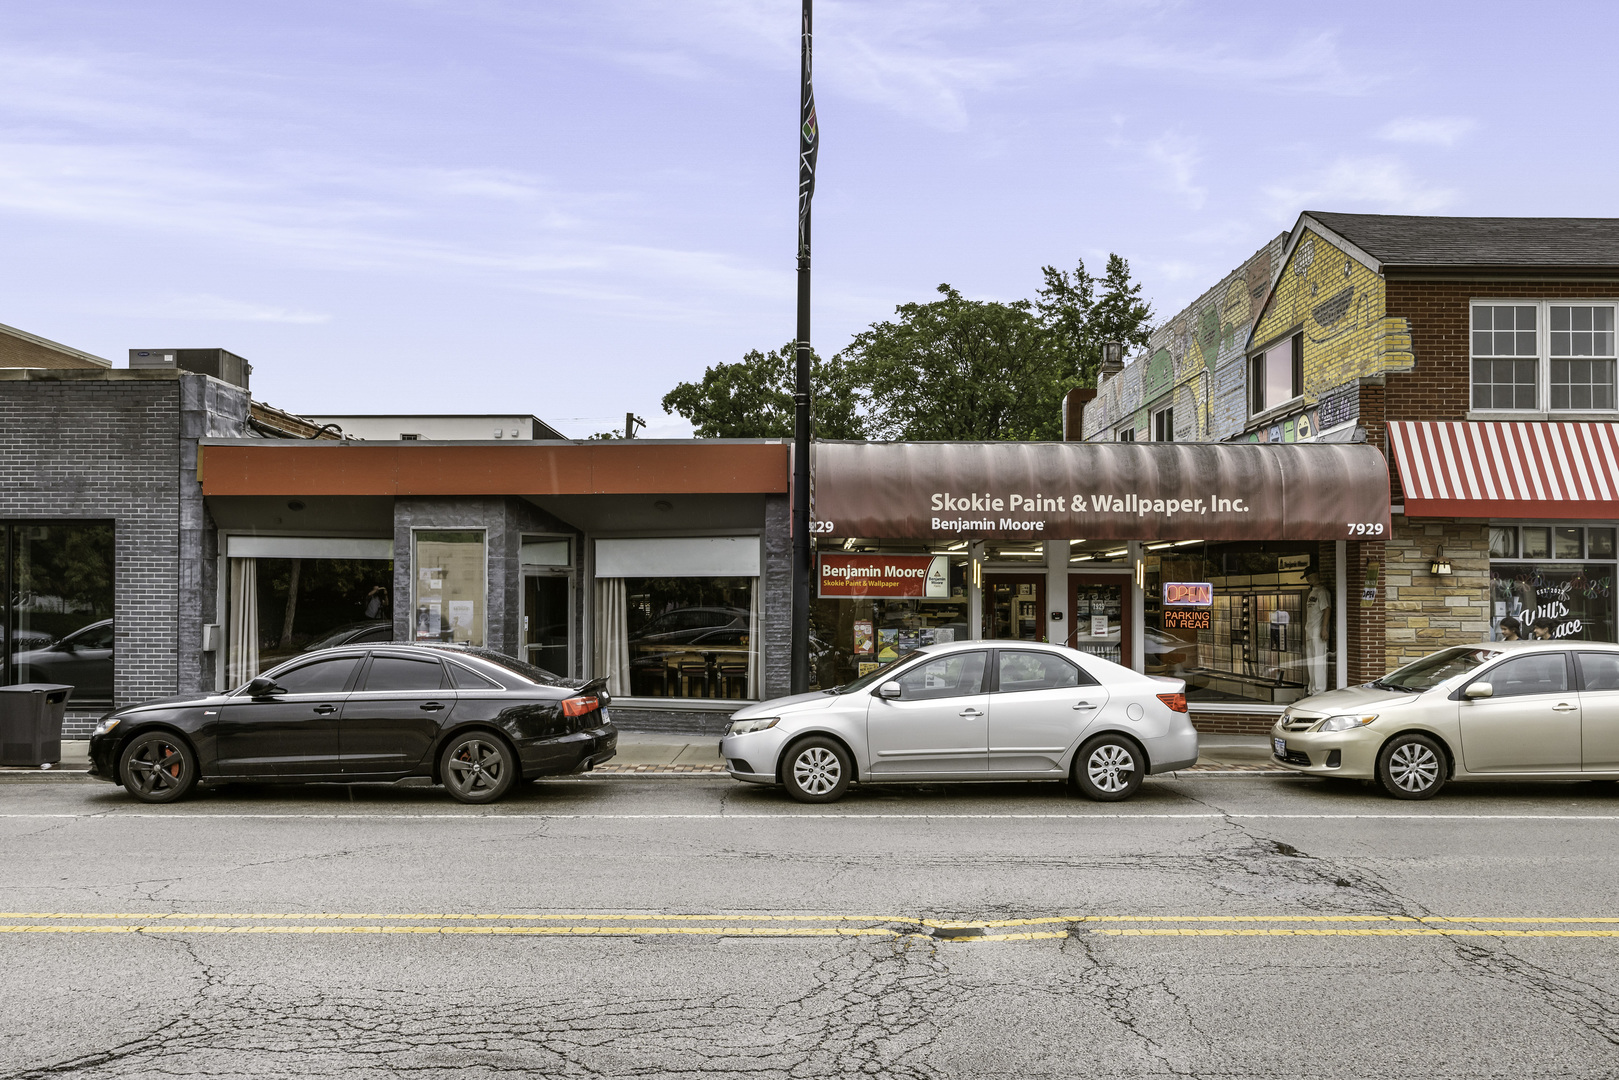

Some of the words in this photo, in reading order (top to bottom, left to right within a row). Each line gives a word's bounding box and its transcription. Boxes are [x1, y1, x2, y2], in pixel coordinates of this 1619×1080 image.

[931, 492, 1004, 512] Skokie
[1009, 494, 1066, 512] Paint
[1070, 494, 1087, 512] &
[1091, 494, 1206, 517] Wallpaper,
[1211, 494, 1250, 513] Inc.
[809, 520, 834, 533] 29
[931, 517, 996, 533] Benjamin
[999, 518, 1045, 531] Moore
[1347, 523, 1384, 535] 7929
[822, 564, 881, 580] Benjamin
[884, 565, 925, 578] Moore
[823, 579, 845, 587] Skokie
[868, 580, 900, 588] Wallpaper
[1167, 585, 1210, 603] OPEN
[1164, 611, 1210, 620] PARKING
[1519, 601, 1570, 627] Will's
[1165, 619, 1176, 628] IN
[1180, 619, 1209, 629] REAR
[1551, 619, 1583, 639] ace
